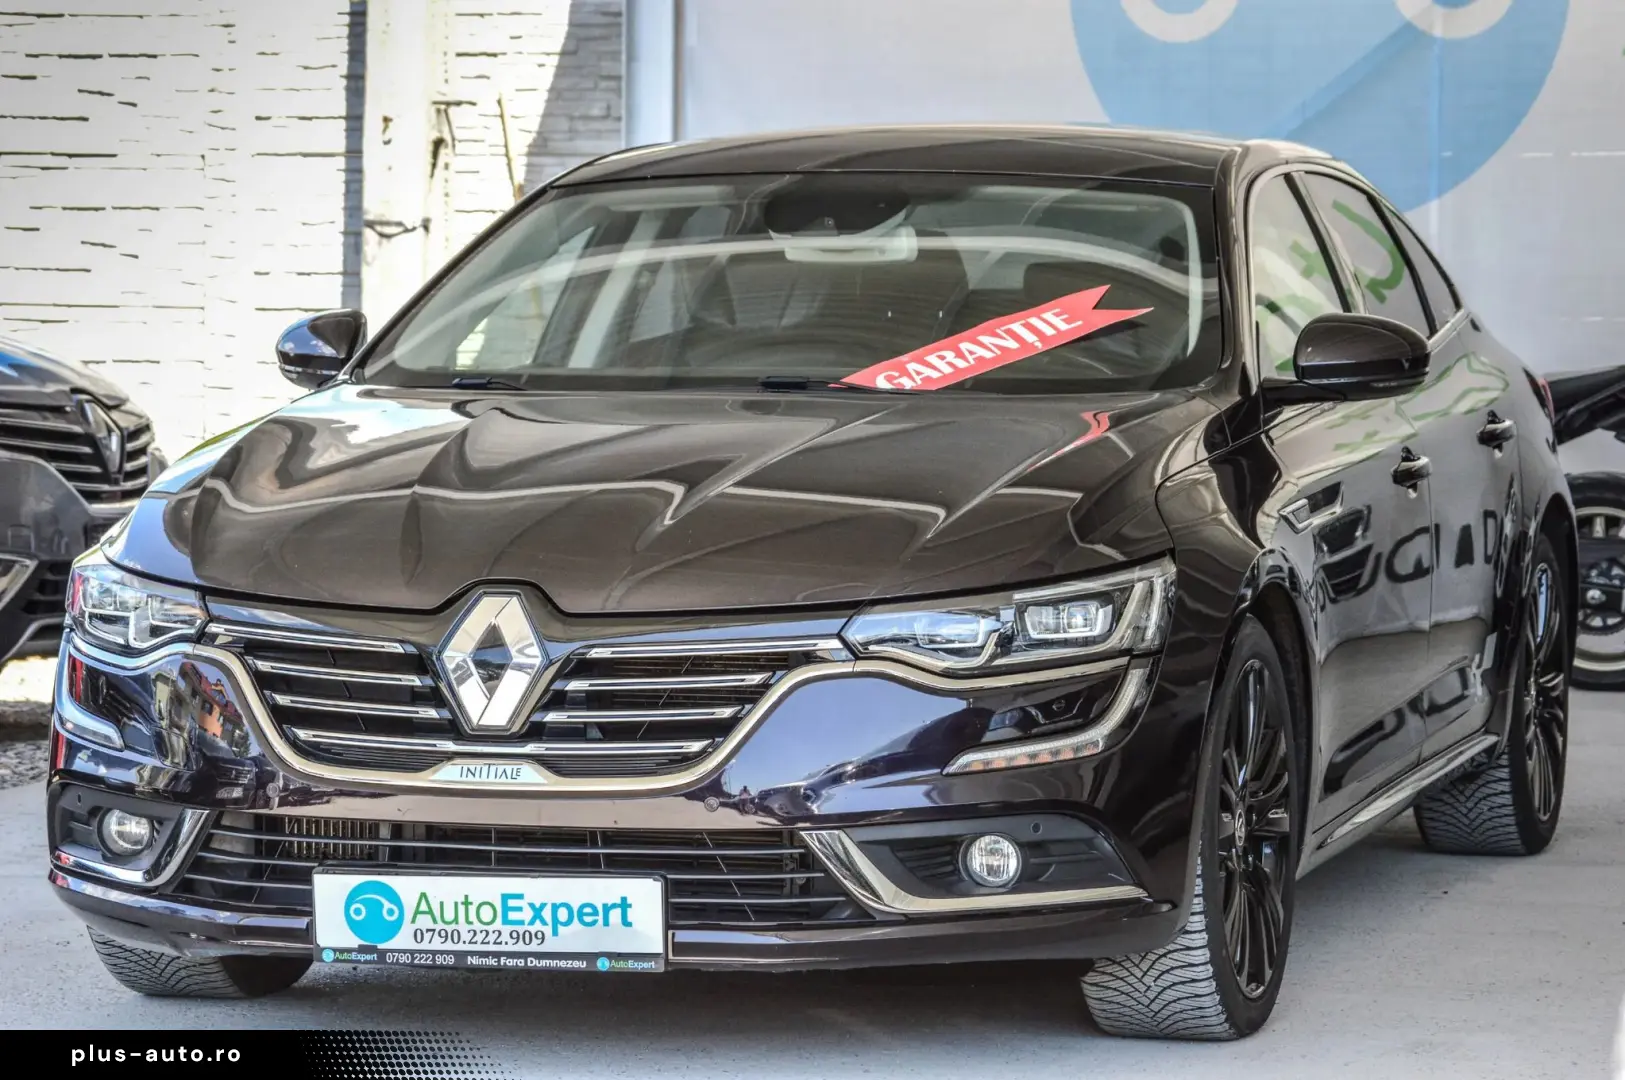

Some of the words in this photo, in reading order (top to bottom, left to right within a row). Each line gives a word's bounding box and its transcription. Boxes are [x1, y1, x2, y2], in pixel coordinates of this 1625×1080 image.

[460, 763, 522, 780] INITIALE
[410, 891, 633, 937] AutoExpert
[413, 928, 546, 946] 0790.222.909
[334, 952, 378, 962] AutoExpert
[386, 953, 412, 964] 0790
[413, 953, 433, 964] 222
[435, 954, 455, 965] 909
[467, 955, 498, 967] Nimic
[500, 956, 525, 967] Fara
[527, 957, 587, 968] Dumnezeu
[610, 959, 655, 970] AutoExpert
